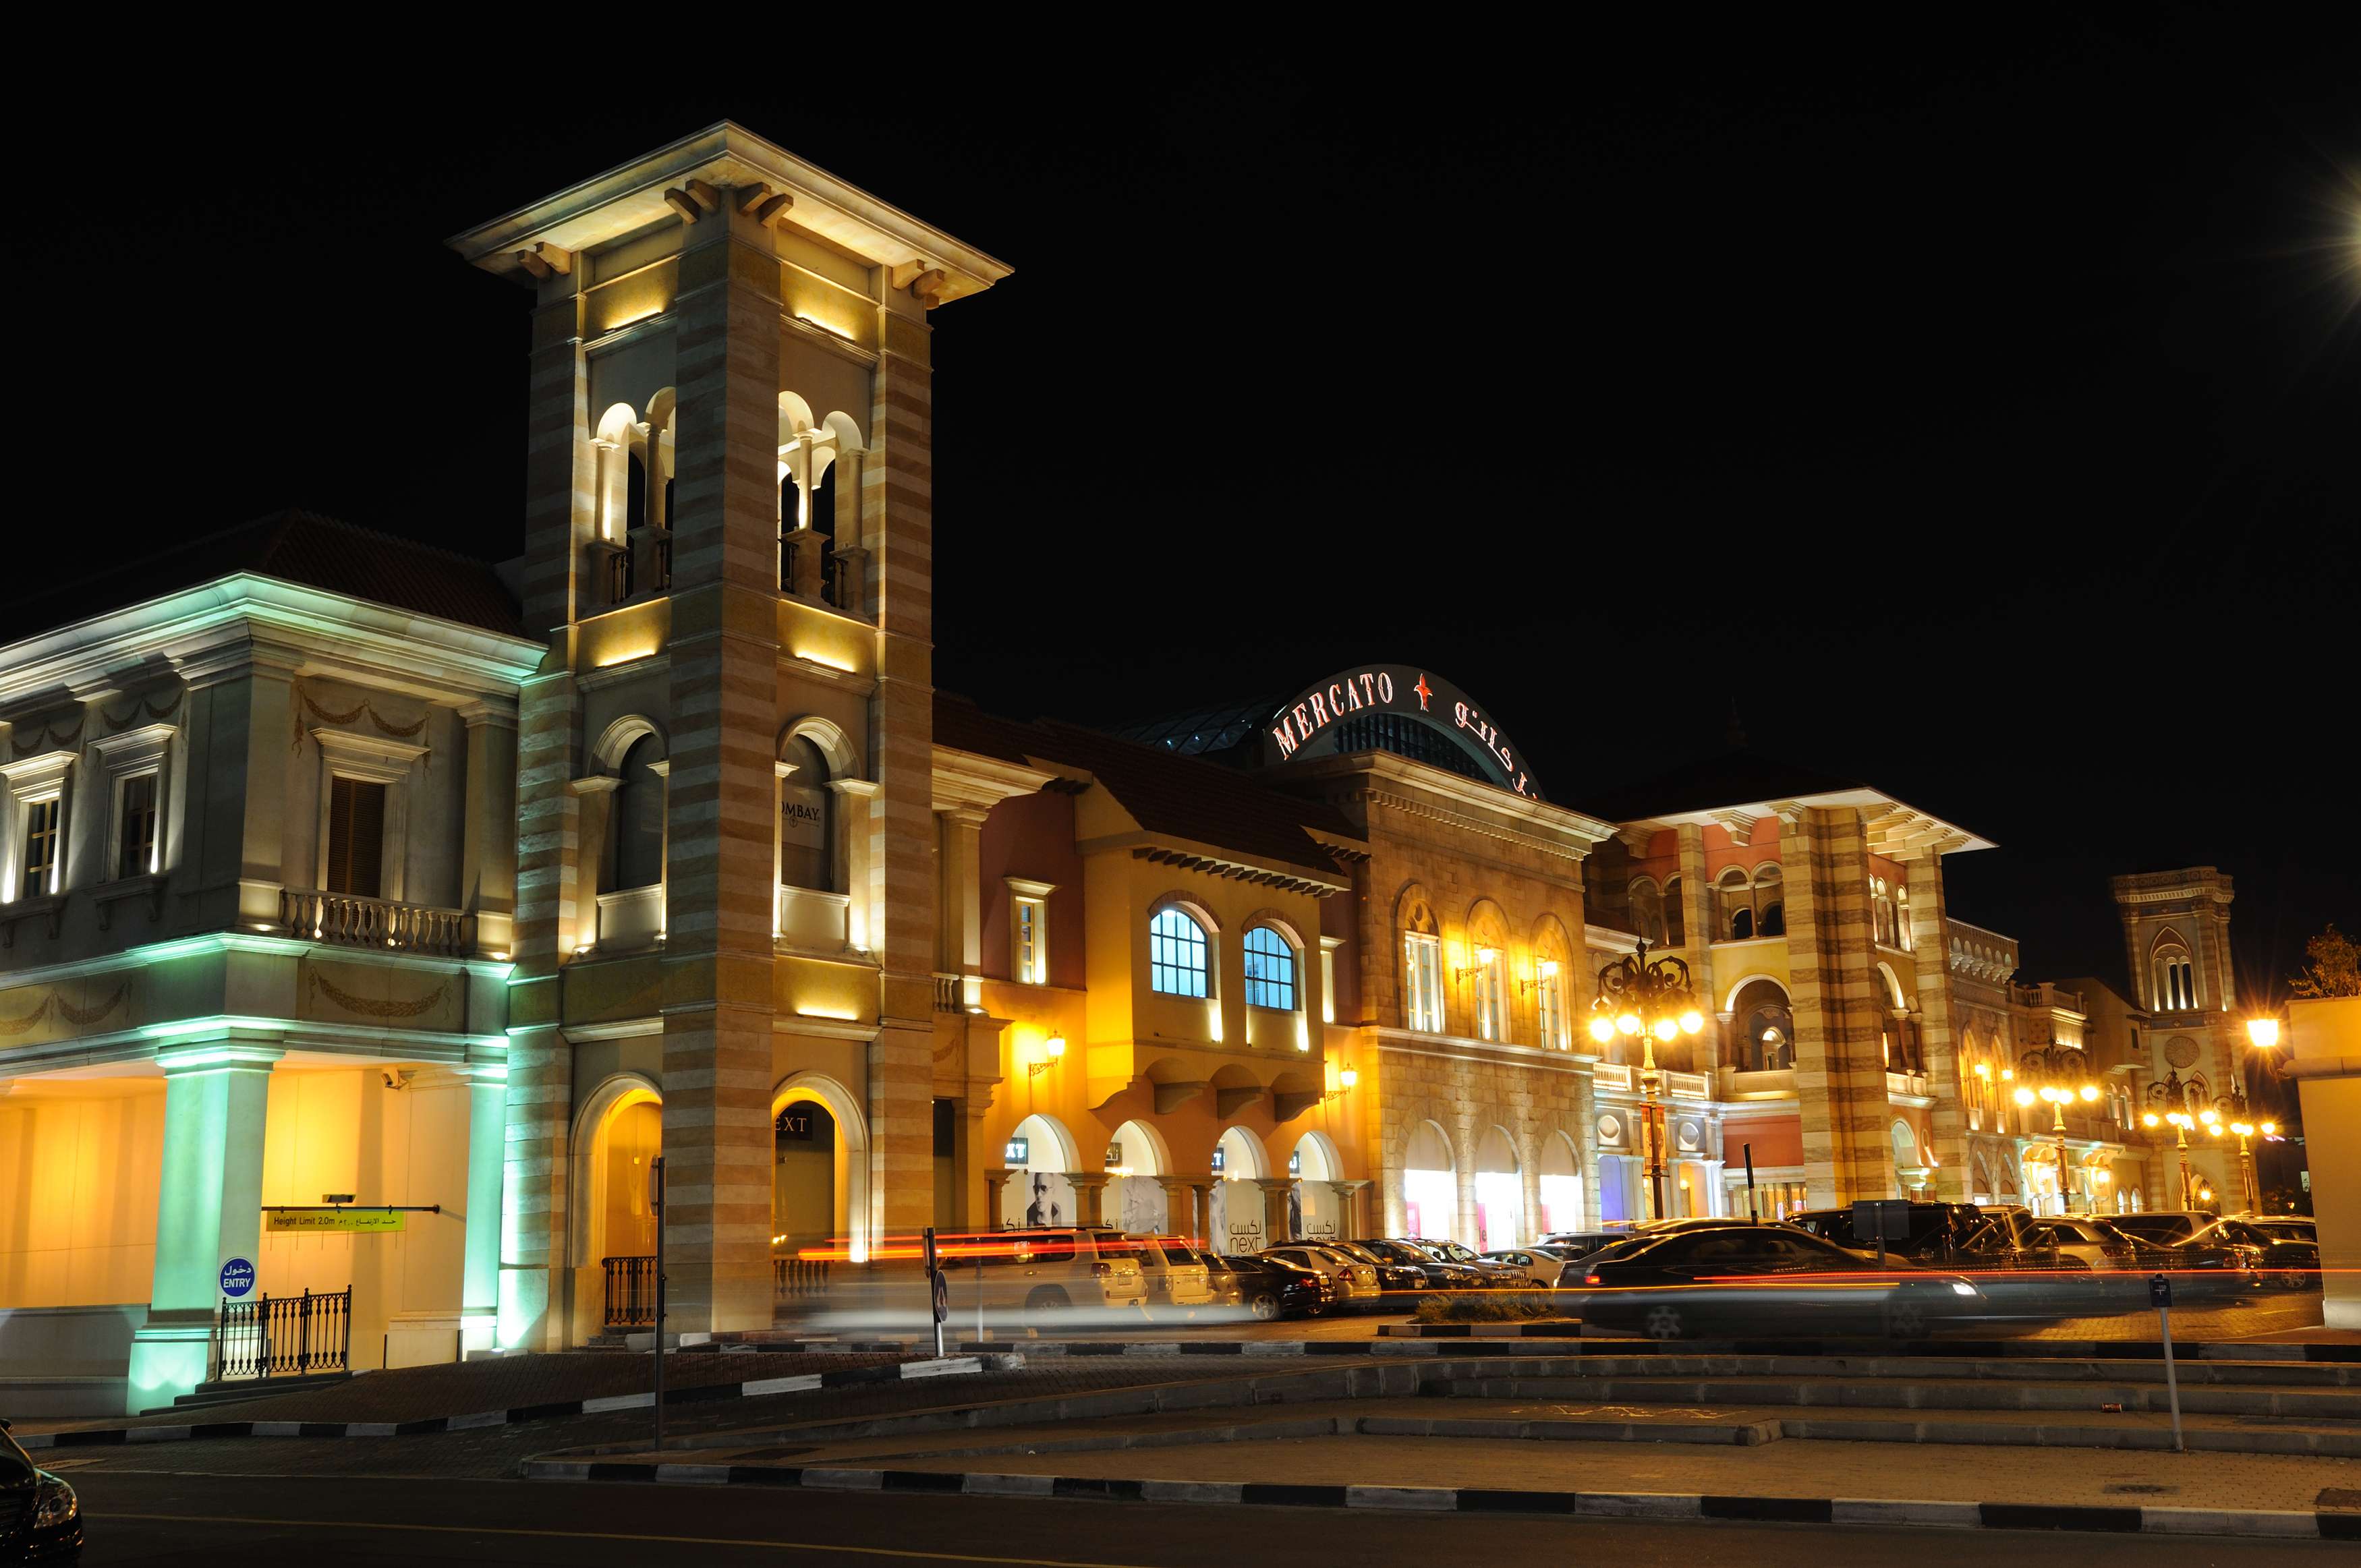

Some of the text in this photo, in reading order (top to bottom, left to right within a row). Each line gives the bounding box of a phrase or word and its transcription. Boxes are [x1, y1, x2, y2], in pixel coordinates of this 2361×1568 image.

[1272, 672, 1393, 761] MERCATO
[775, 1116, 807, 1132] EXT
[274, 1216, 335, 1227] Height Limit 2.0m
[1230, 1236, 1261, 1253] next
[224, 1265, 252, 1276] دخول
[223, 1277, 251, 1288] ENTRY
